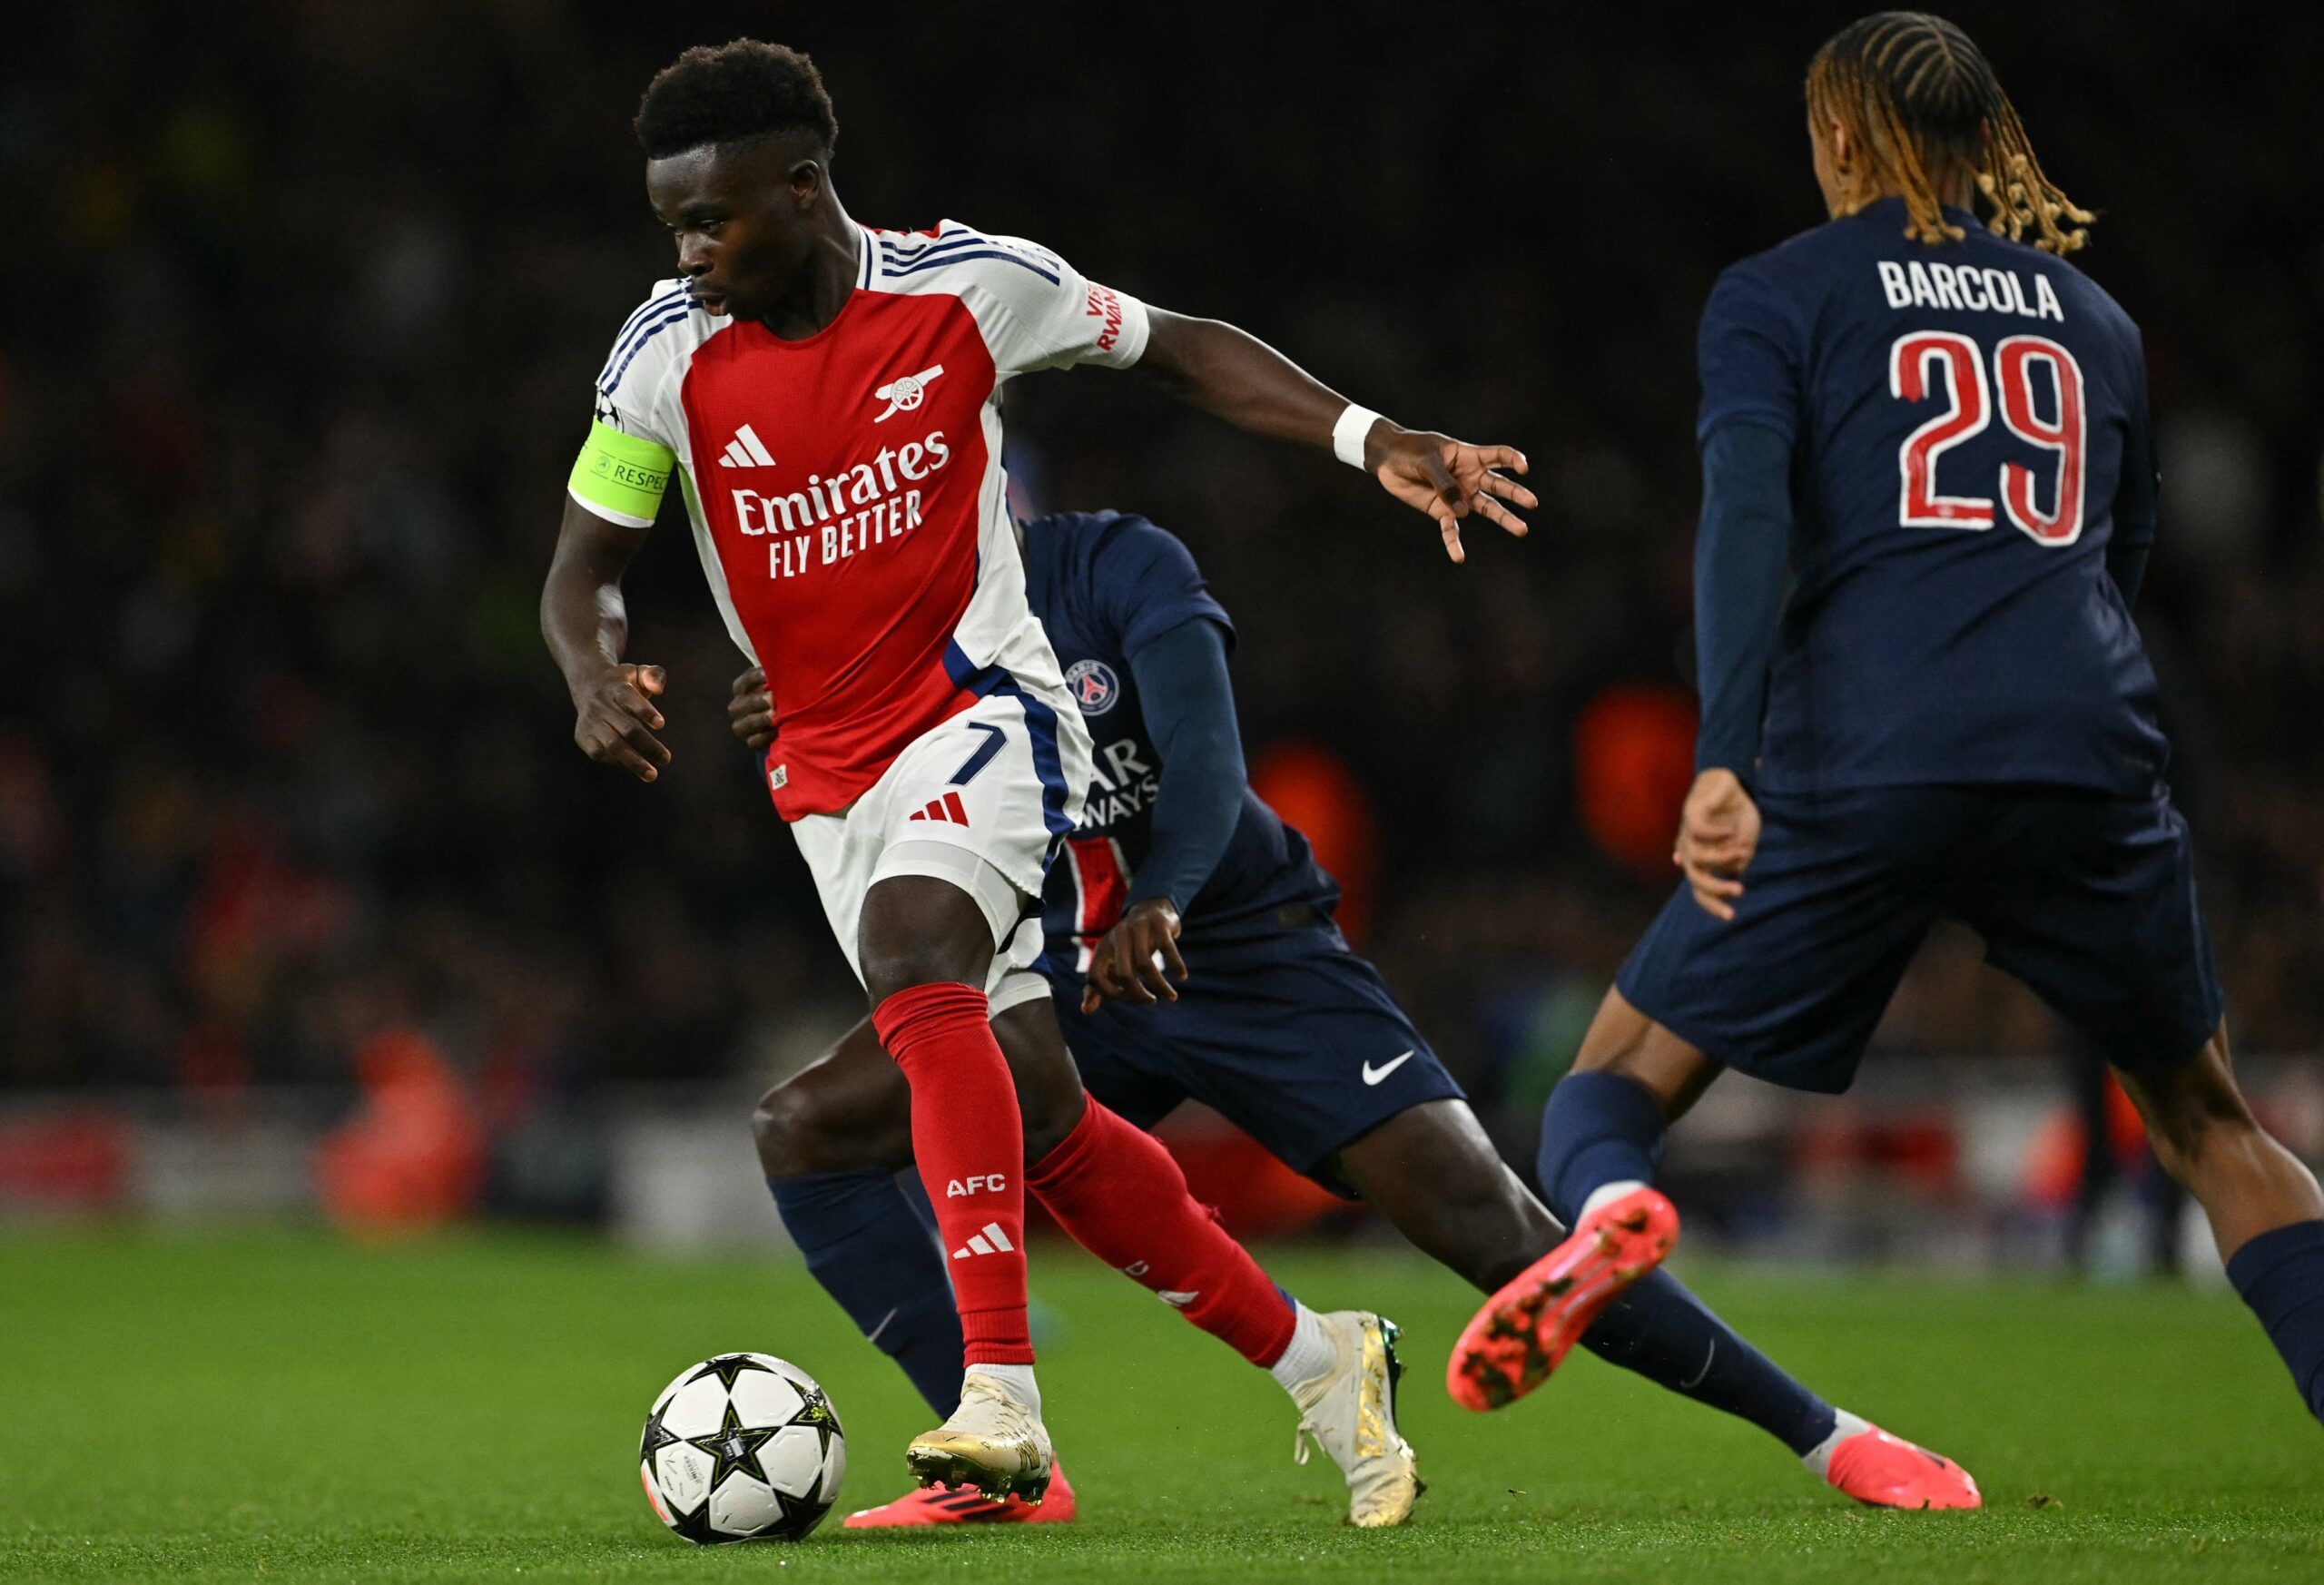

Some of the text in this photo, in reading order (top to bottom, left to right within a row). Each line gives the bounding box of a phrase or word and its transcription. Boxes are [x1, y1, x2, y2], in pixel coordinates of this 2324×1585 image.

[1877, 261, 2065, 323] BARCOLA
[1889, 330, 2087, 547] 29
[732, 430, 950, 537] Emirates
[770, 489, 922, 579] FLY BETTER
[945, 720, 1009, 787] 7
[946, 1174, 1006, 1198] AFC
